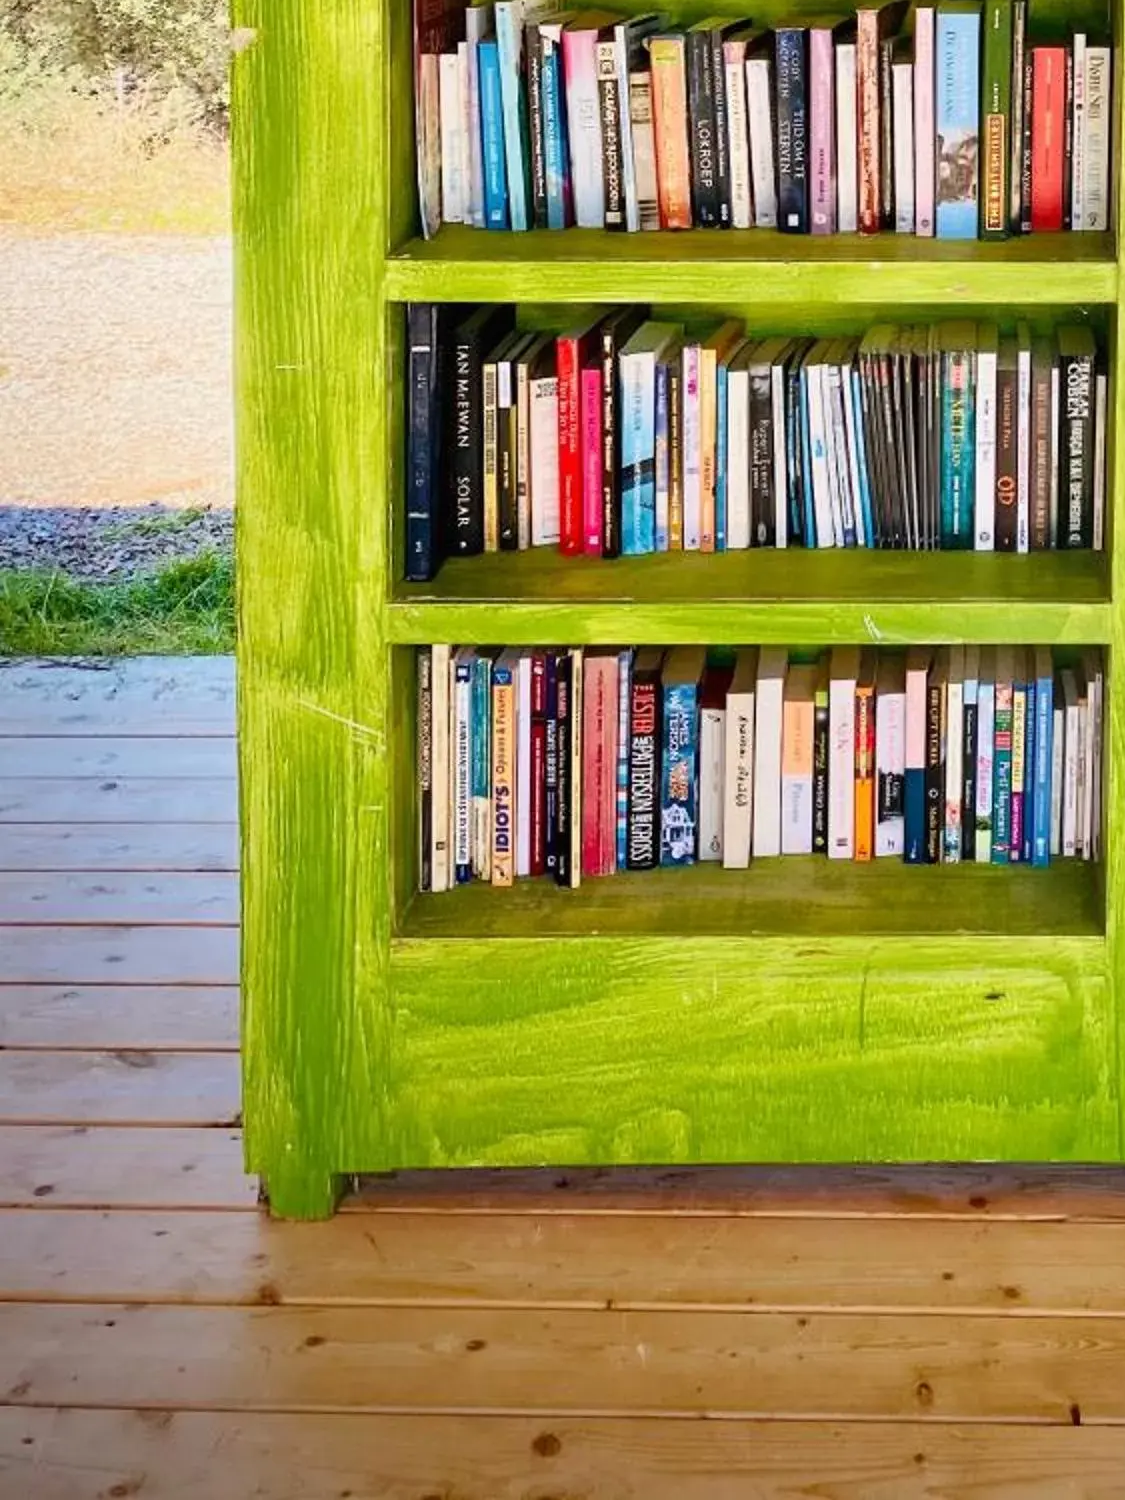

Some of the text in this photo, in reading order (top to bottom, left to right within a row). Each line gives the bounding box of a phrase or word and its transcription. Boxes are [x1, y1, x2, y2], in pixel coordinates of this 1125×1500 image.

[697, 119, 713, 188] LOKROEP
[456, 345, 470, 527] IAN McEWAN SOLAR
[633, 693, 655, 734] JESTER
[631, 746, 655, 811] PATTERSON
[495, 785, 509, 853] IDIOT'S
